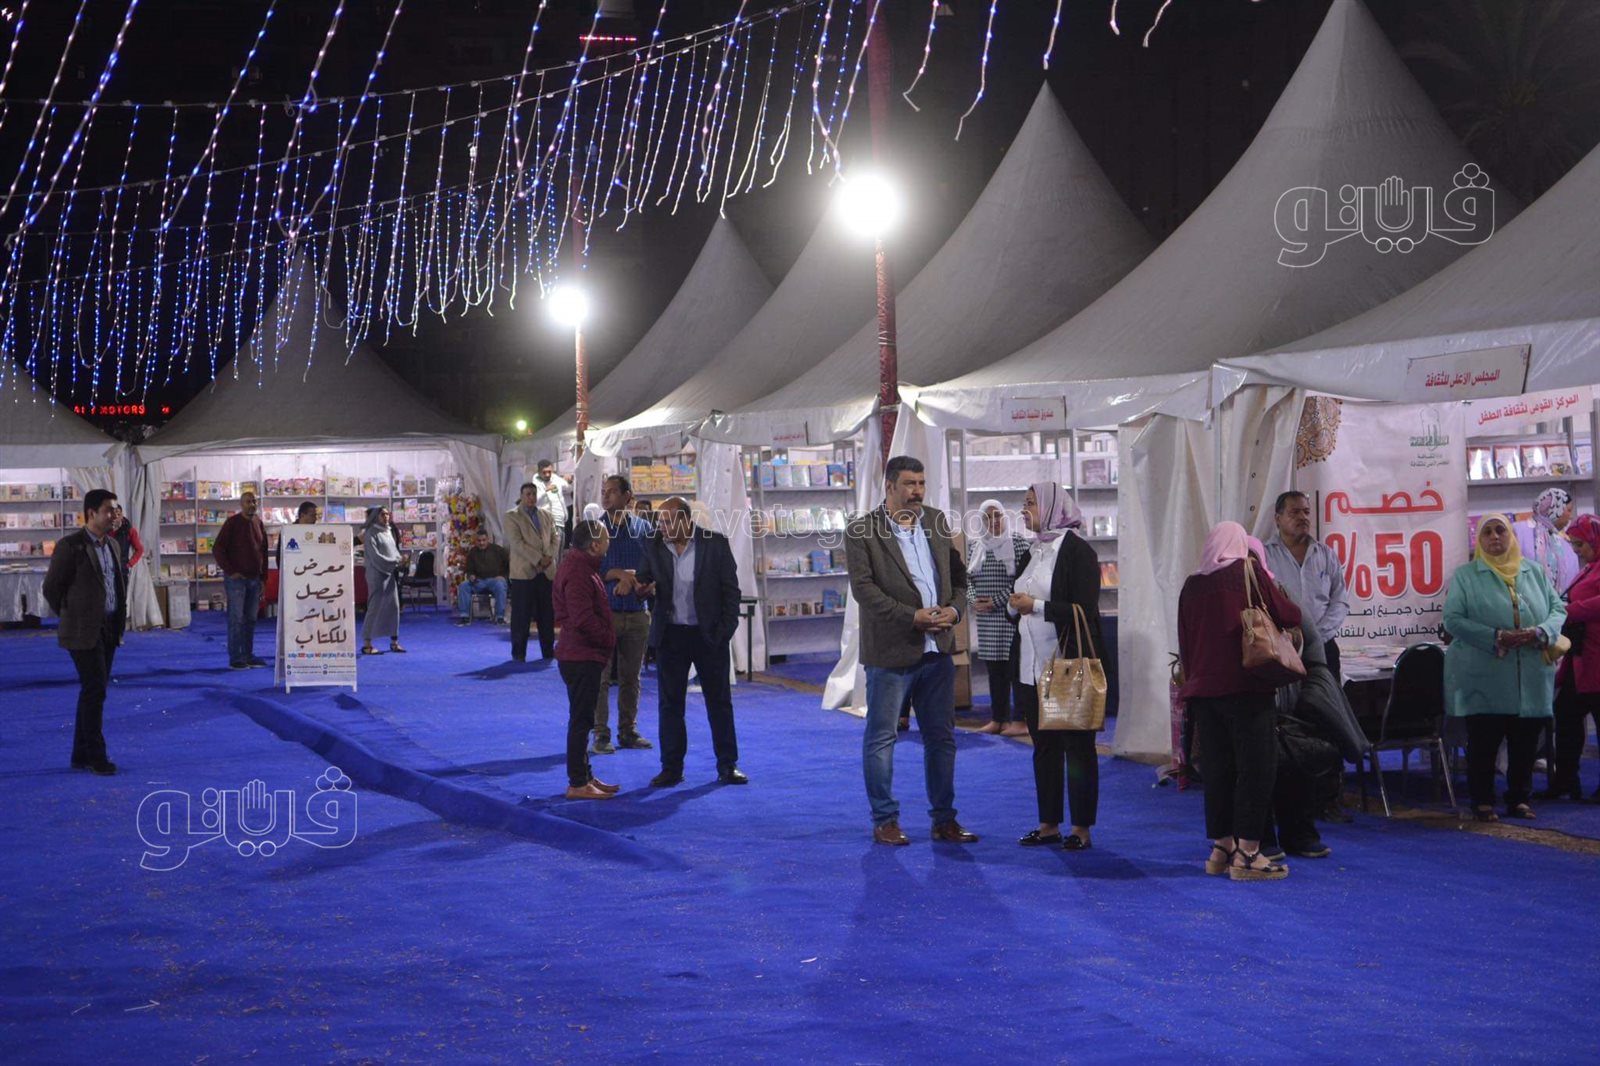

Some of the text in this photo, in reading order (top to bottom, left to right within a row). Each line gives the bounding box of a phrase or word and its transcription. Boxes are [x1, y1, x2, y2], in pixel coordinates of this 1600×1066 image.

[1471, 369, 1500, 386] المجلس
[100, 405, 145, 415] MOTORS
[1556, 393, 1579, 410] المركز
[1478, 409, 1502, 425] الطفل
[1325, 481, 1444, 522] خصم
[293, 558, 345, 576] معرض
[296, 583, 344, 603] فيصل
[296, 608, 346, 623] العاشر
[1377, 604, 1412, 617] جميع
[1415, 602, 1442, 615] على
[295, 625, 347, 649] للكتاب
